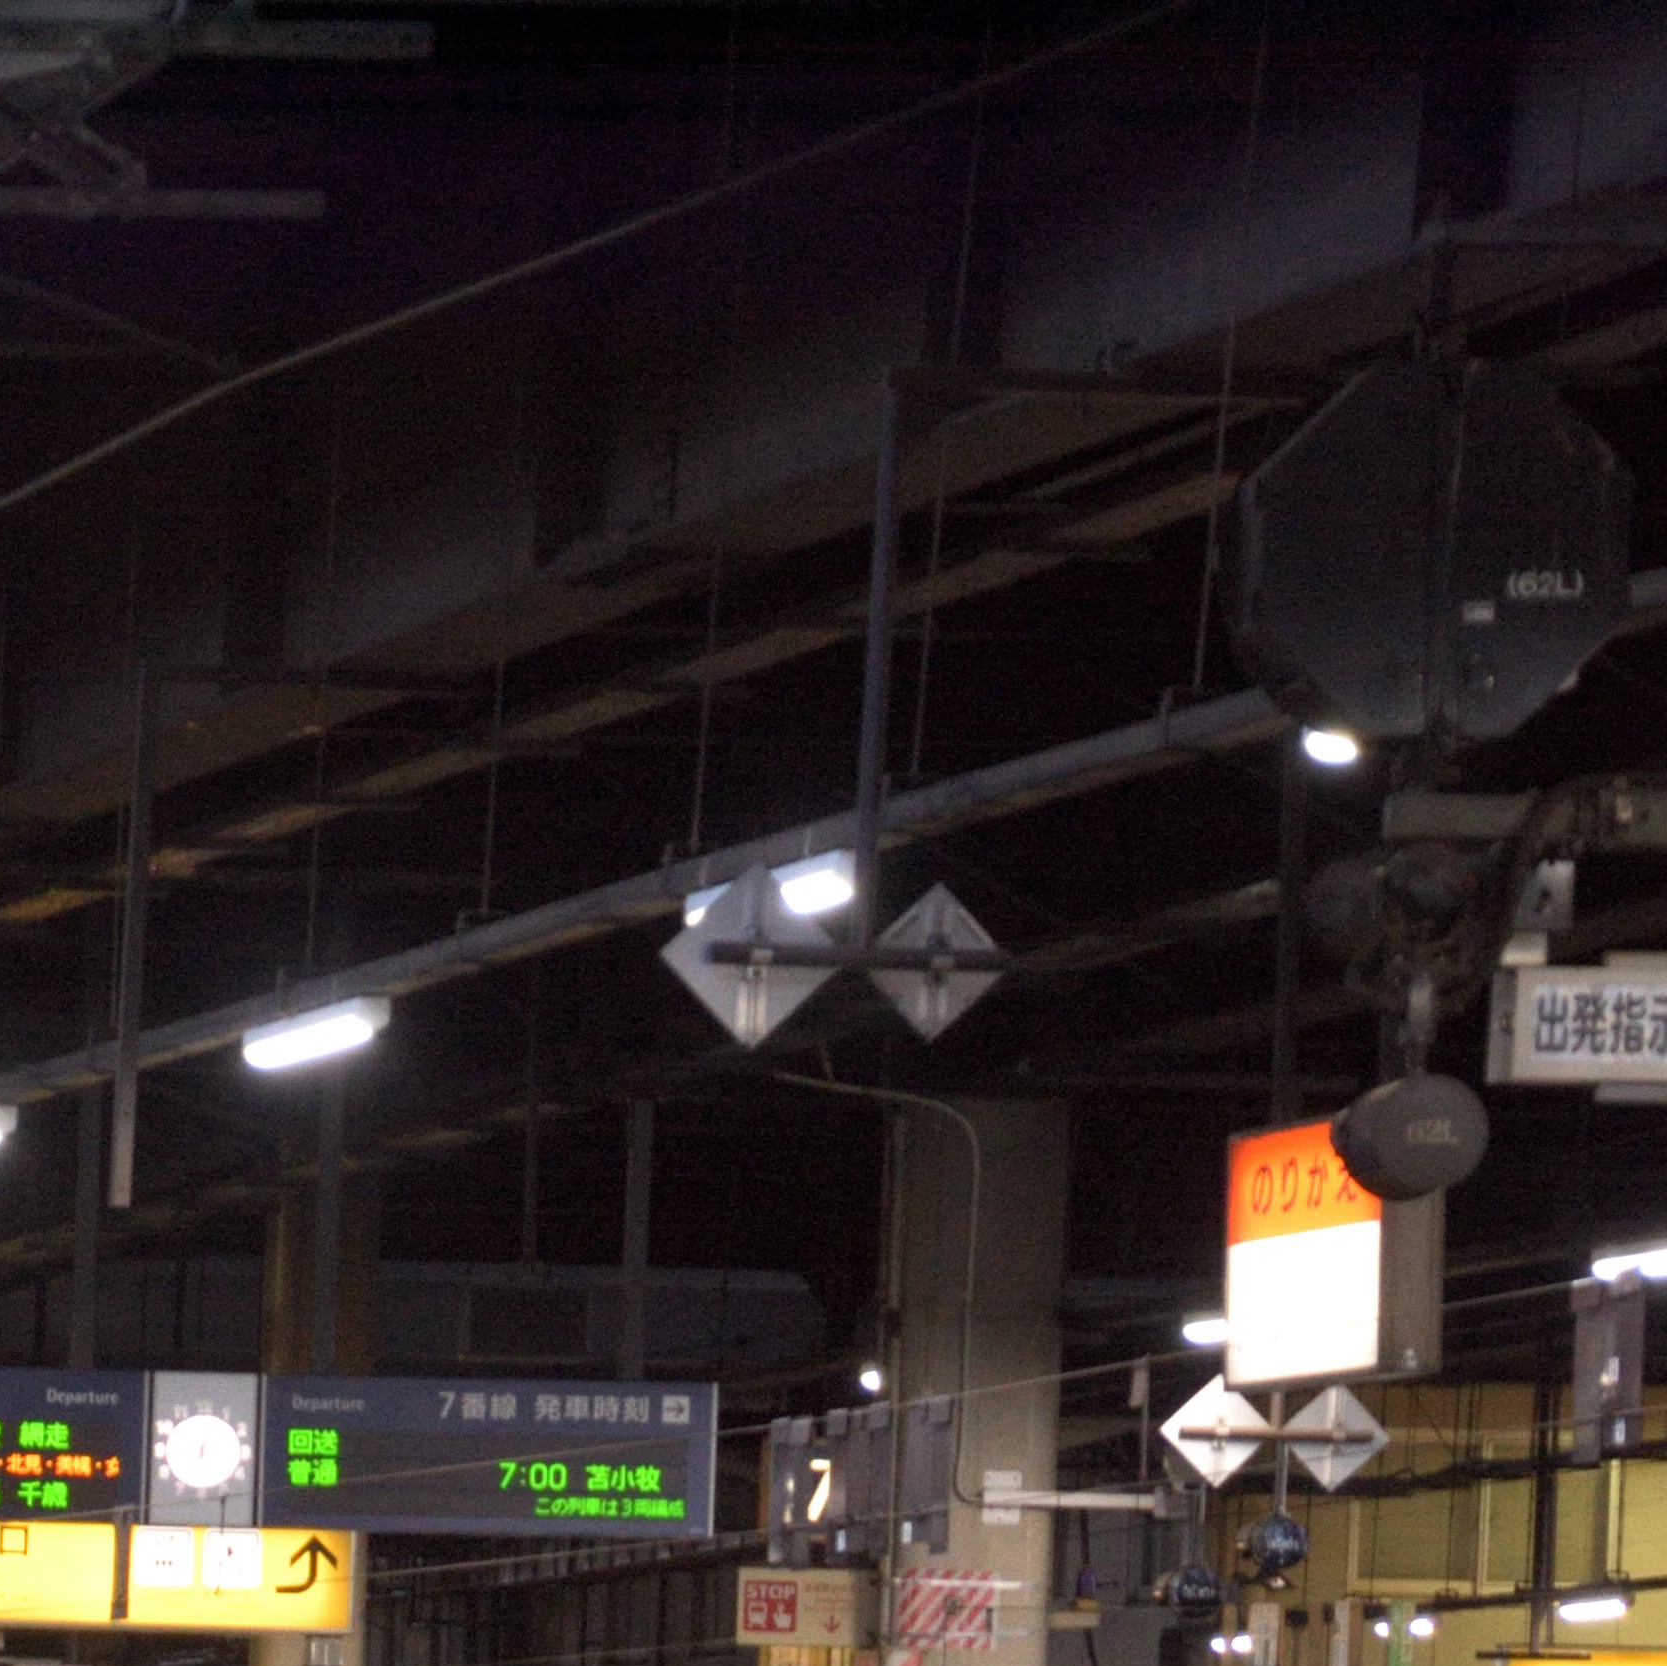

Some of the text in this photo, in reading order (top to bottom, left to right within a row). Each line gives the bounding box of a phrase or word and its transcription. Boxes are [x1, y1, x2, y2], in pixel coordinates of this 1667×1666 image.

[19, 1421, 70, 1449] 網走
[288, 1428, 338, 1456] 回送
[287, 1458, 662, 1493] 普通 7:00 苫小牧
[807, 1458, 831, 1522] 7
[746, 1584, 795, 1599] STOP
